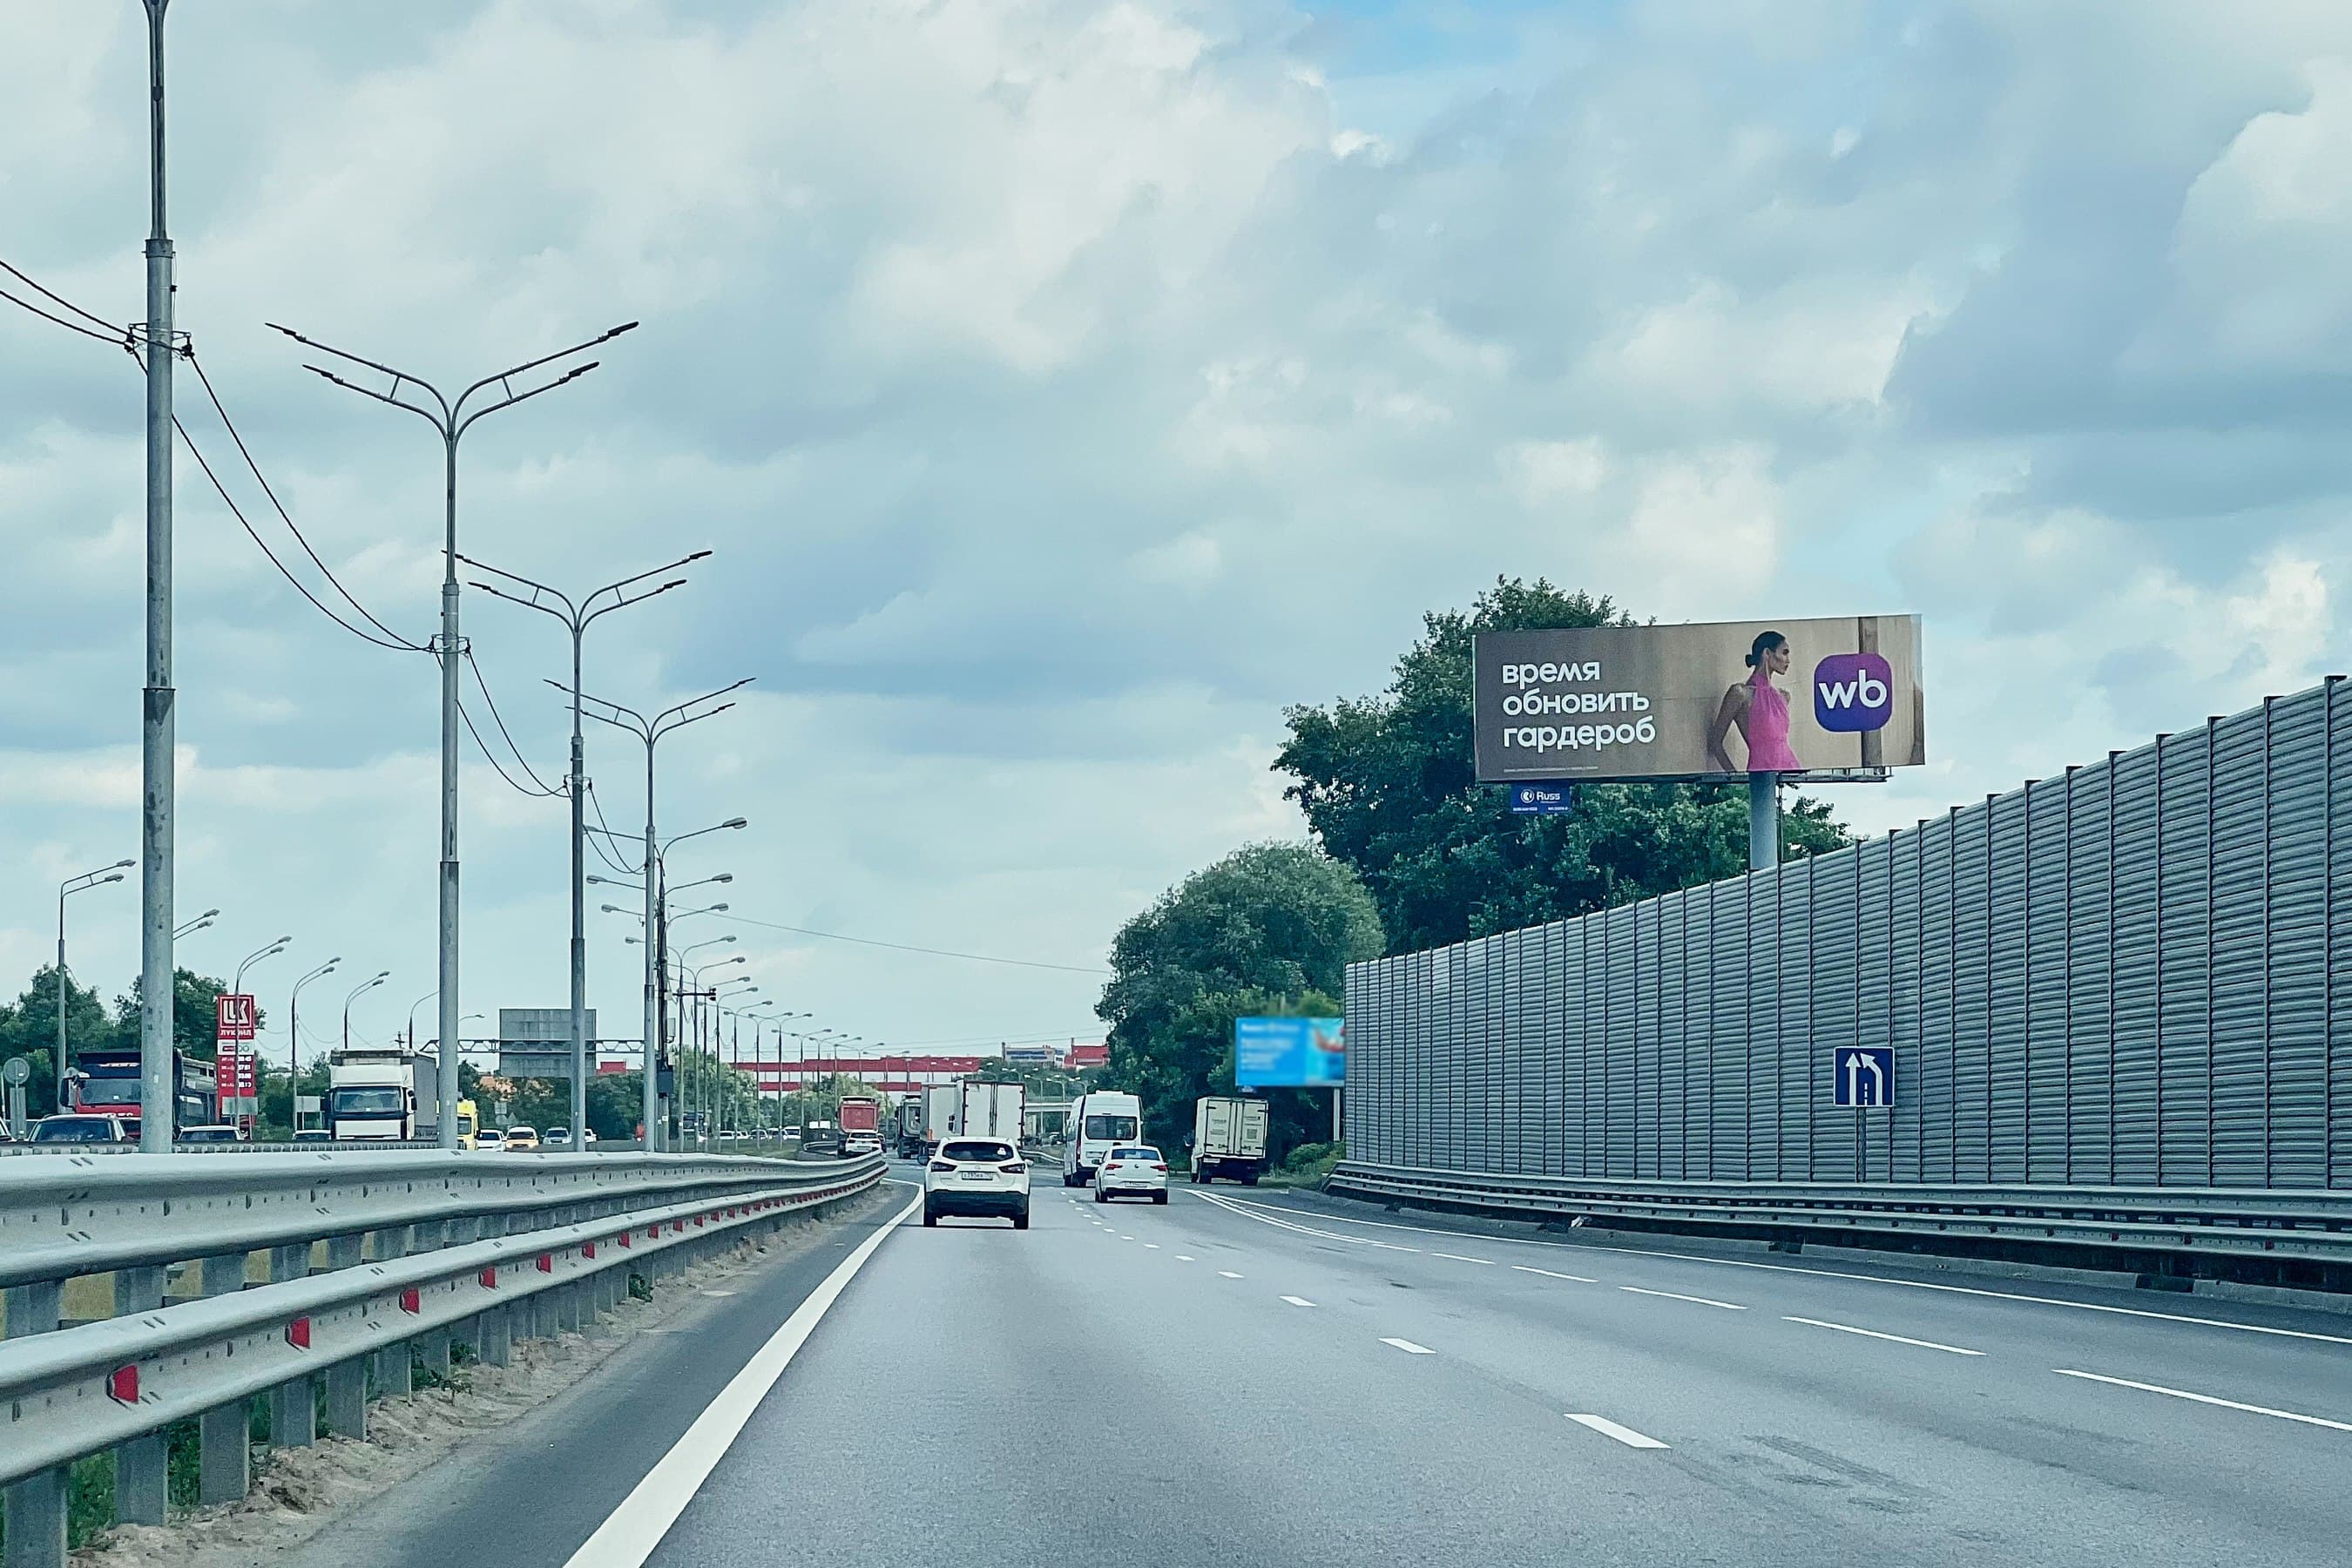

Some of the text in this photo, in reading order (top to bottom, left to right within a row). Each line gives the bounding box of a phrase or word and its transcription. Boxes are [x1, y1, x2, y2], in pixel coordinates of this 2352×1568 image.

[1502, 661, 1600, 690] время
[1818, 669, 1888, 709] wb
[1503, 687, 1650, 716] обновить
[1504, 714, 1656, 754] гардероб
